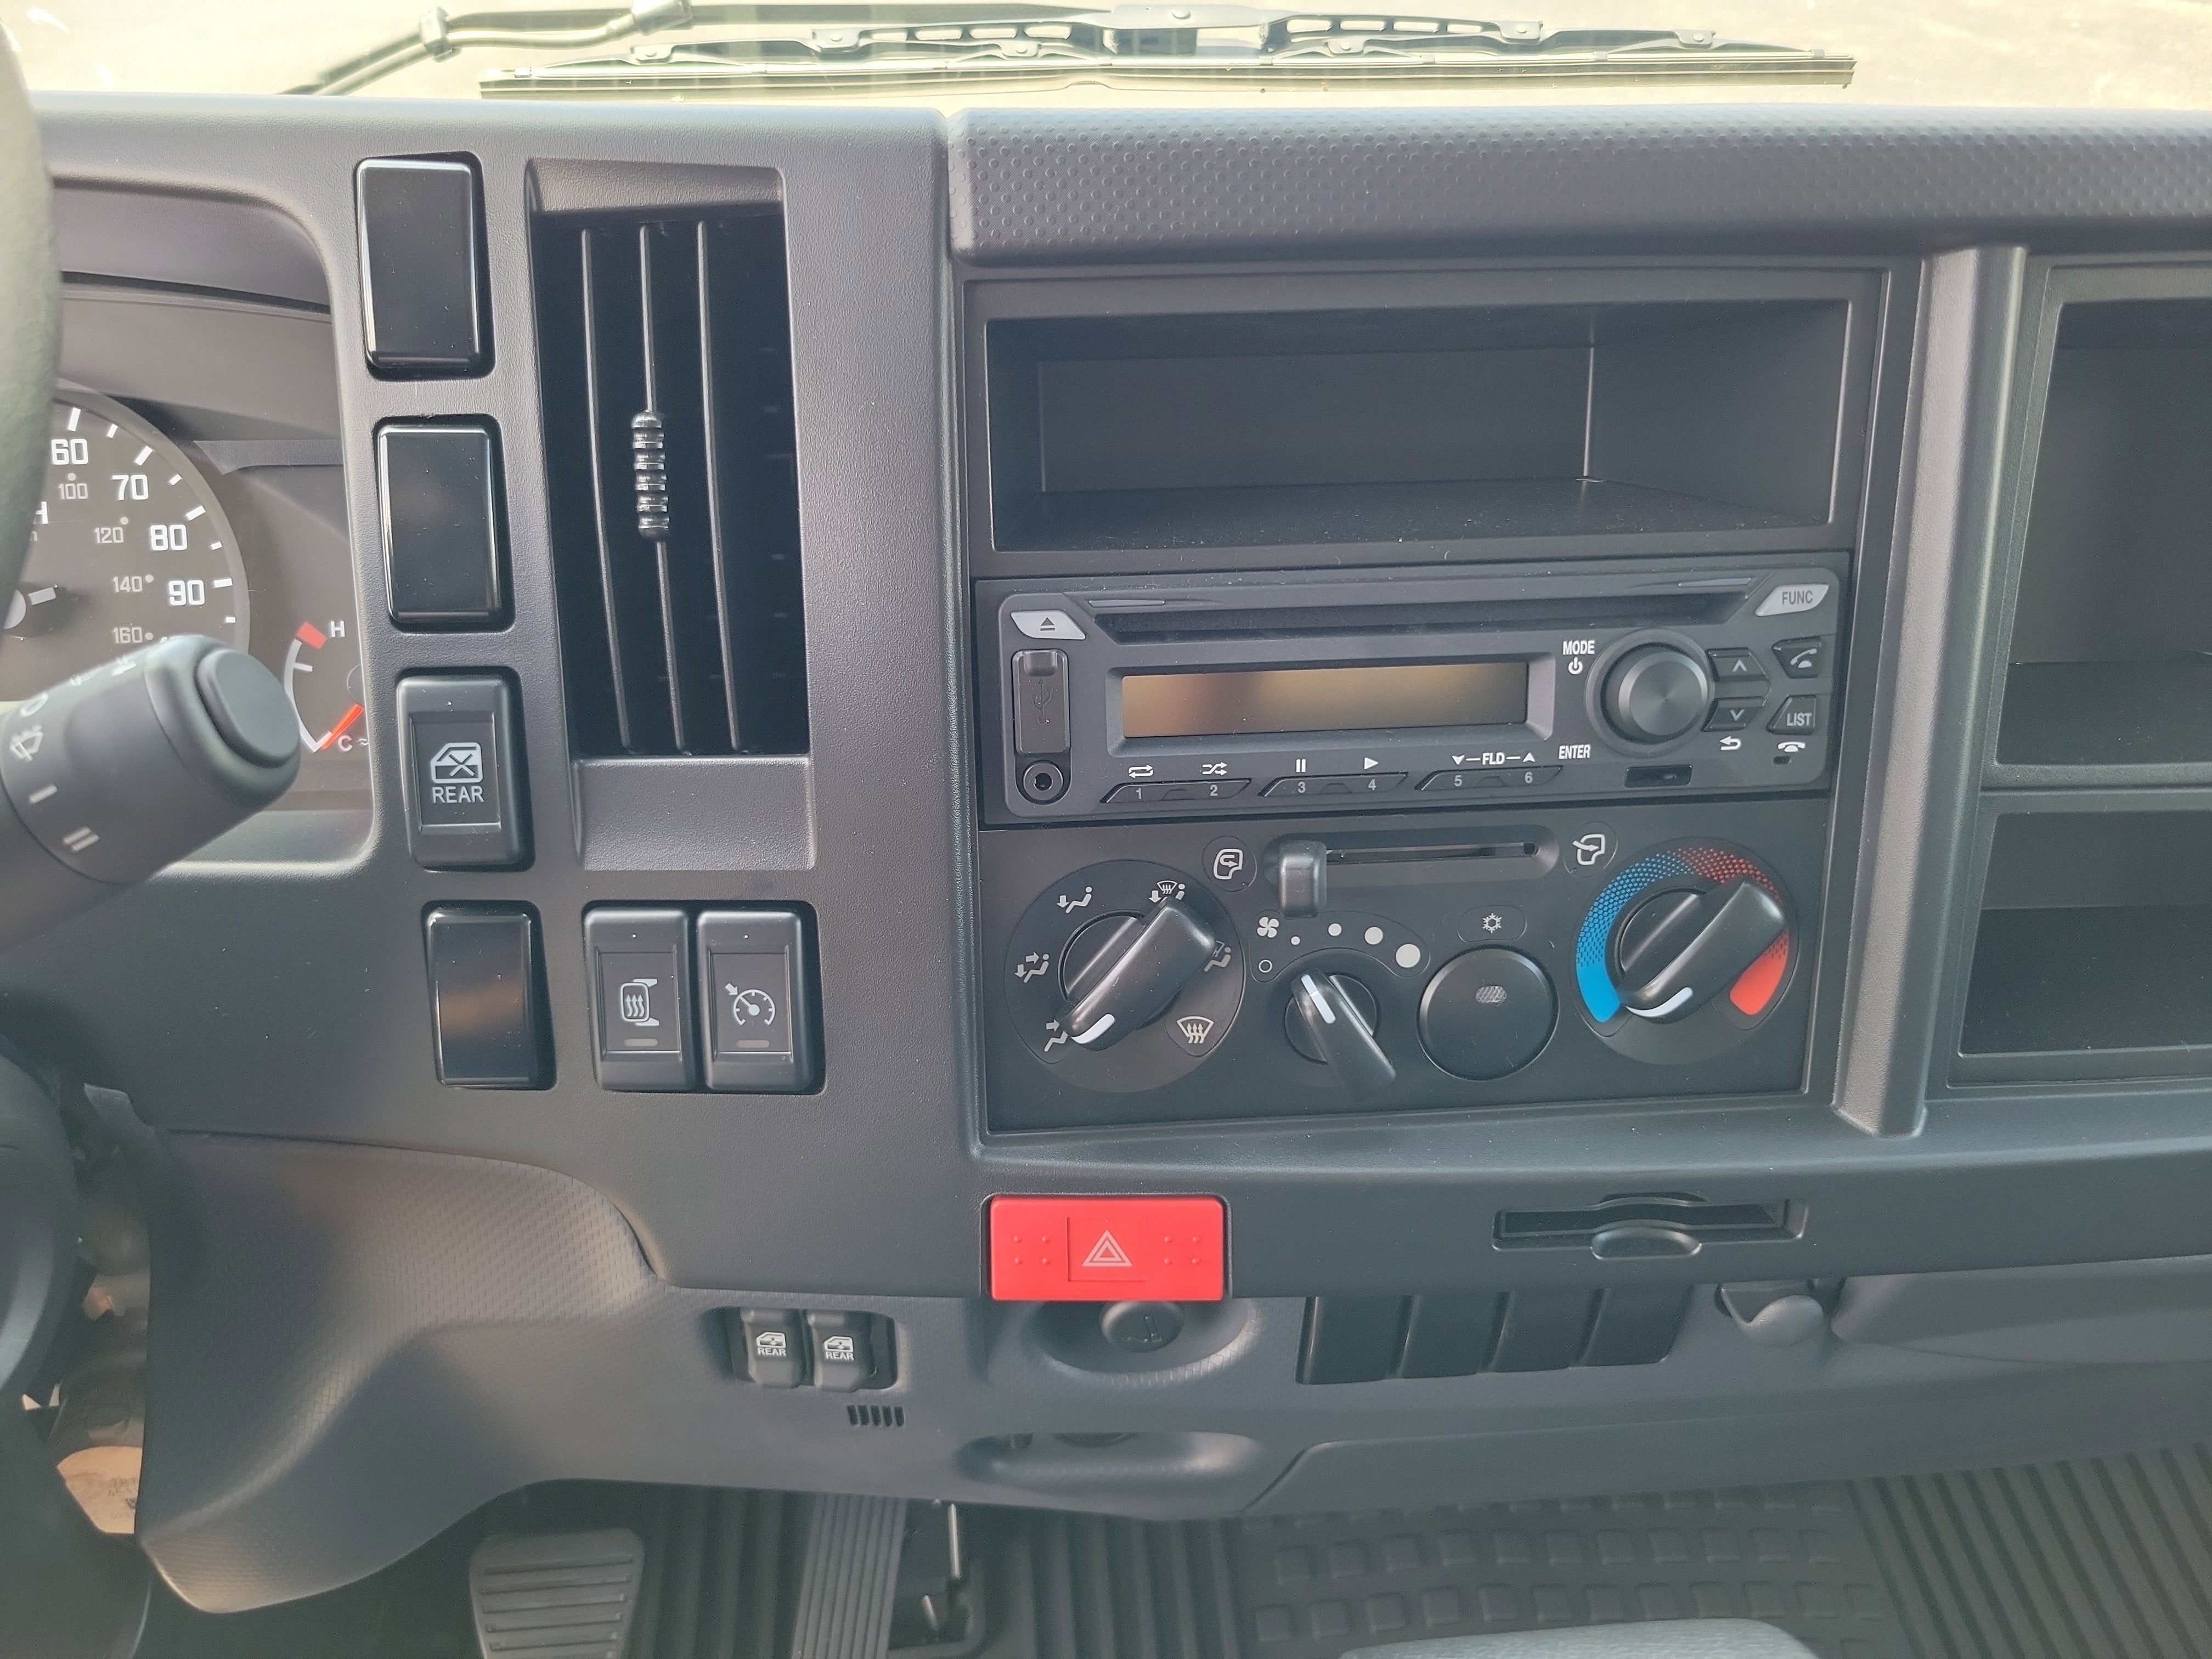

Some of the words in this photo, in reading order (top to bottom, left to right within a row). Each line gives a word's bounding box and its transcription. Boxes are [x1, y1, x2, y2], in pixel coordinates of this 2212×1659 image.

[51, 439, 88, 465] 60
[59, 483, 88, 499] 100
[112, 475, 149, 500] 70
[94, 527, 124, 543] 120
[150, 524, 187, 550] 80
[113, 576, 143, 592] 140
[168, 580, 205, 605] 90
[1781, 590, 1813, 605] FUNC
[113, 627, 143, 644] 160
[330, 620, 346, 637] H
[1562, 640, 1595, 655] MODE
[1786, 712, 1812, 726] LIST
[338, 735, 353, 752] C
[1482, 752, 1505, 765] FLD
[1558, 744, 1590, 759] ENTER
[1368, 778, 1376, 791] 4
[1454, 774, 1463, 787] 5
[1524, 771, 1533, 784] 6
[1136, 787, 1142, 799] 1
[1209, 784, 1218, 797] 2
[1297, 781, 1306, 793] 3
[432, 786, 484, 804] REAR
[757, 1347, 787, 1357] REAR
[825, 1351, 855, 1361] REAR
